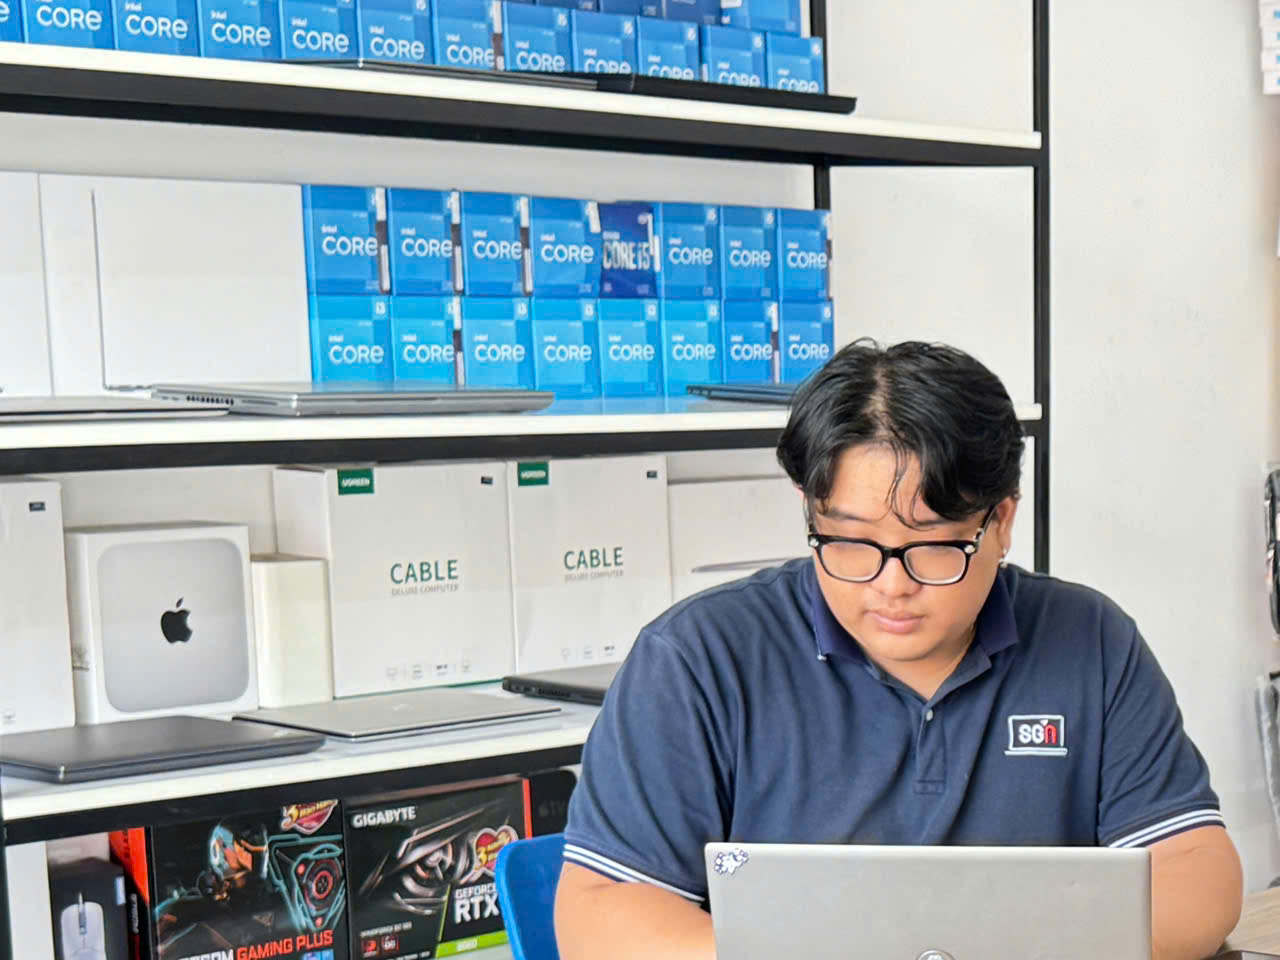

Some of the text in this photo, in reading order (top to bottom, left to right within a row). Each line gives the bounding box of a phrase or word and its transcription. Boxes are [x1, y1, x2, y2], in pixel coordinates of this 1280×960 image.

[564, 547, 624, 570] CABLE
[390, 559, 459, 584] CABLE
[352, 806, 417, 828] GIGABYTE
[455, 893, 500, 924] RTX
[296, 929, 334, 951] PLUS
